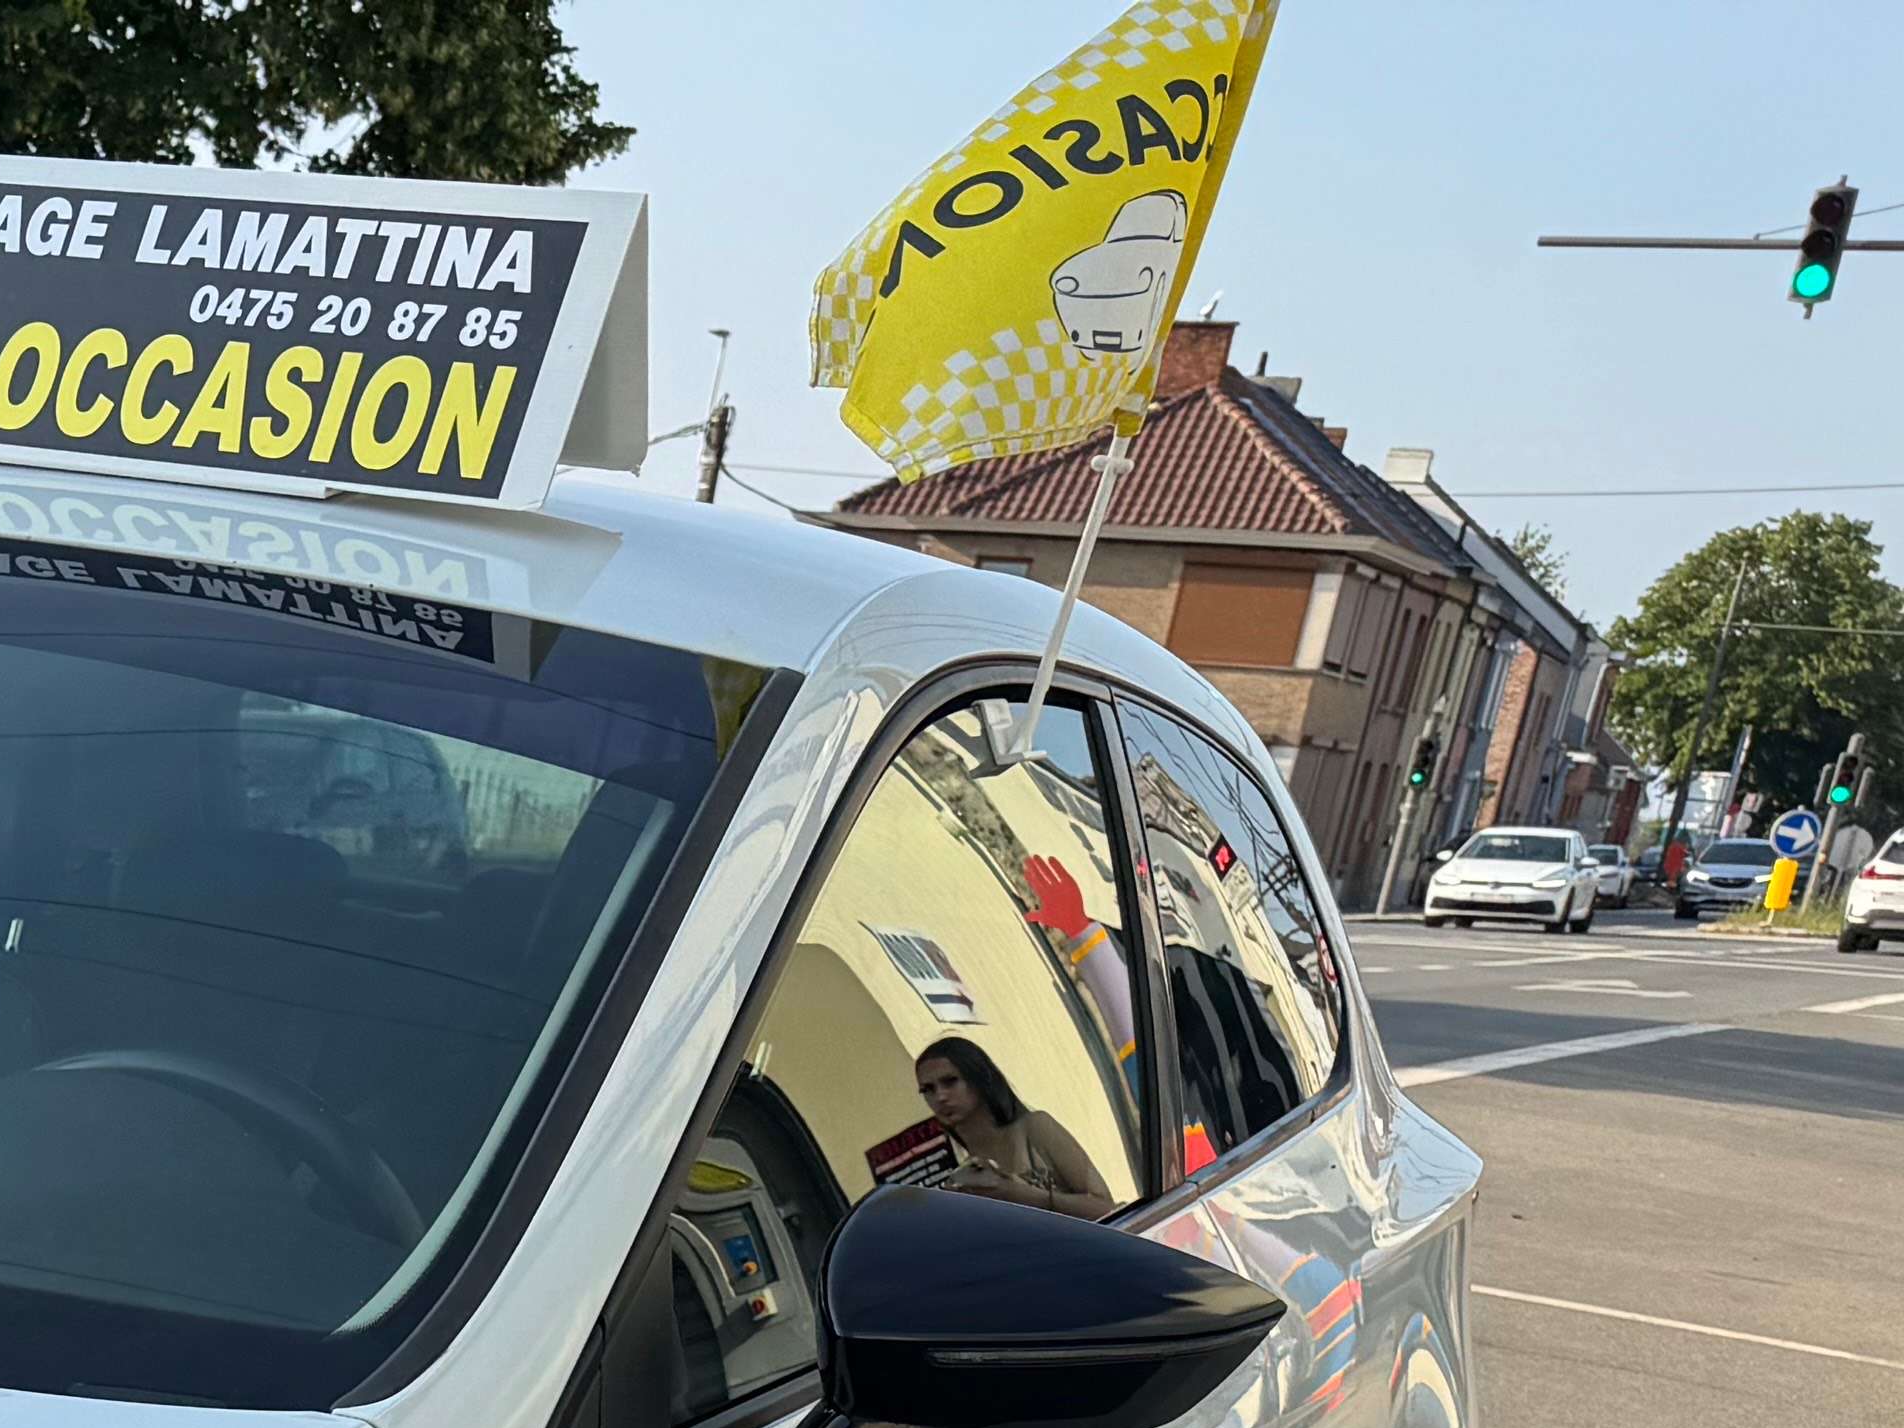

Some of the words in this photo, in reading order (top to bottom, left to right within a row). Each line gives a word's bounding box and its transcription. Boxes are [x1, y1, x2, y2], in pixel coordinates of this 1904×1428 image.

[136, 203, 533, 294] LAMATTINA
[189, 285, 295, 330] 0475
[309, 294, 372, 337] 20
[387, 301, 444, 344] 87
[458, 307, 521, 350] 85
